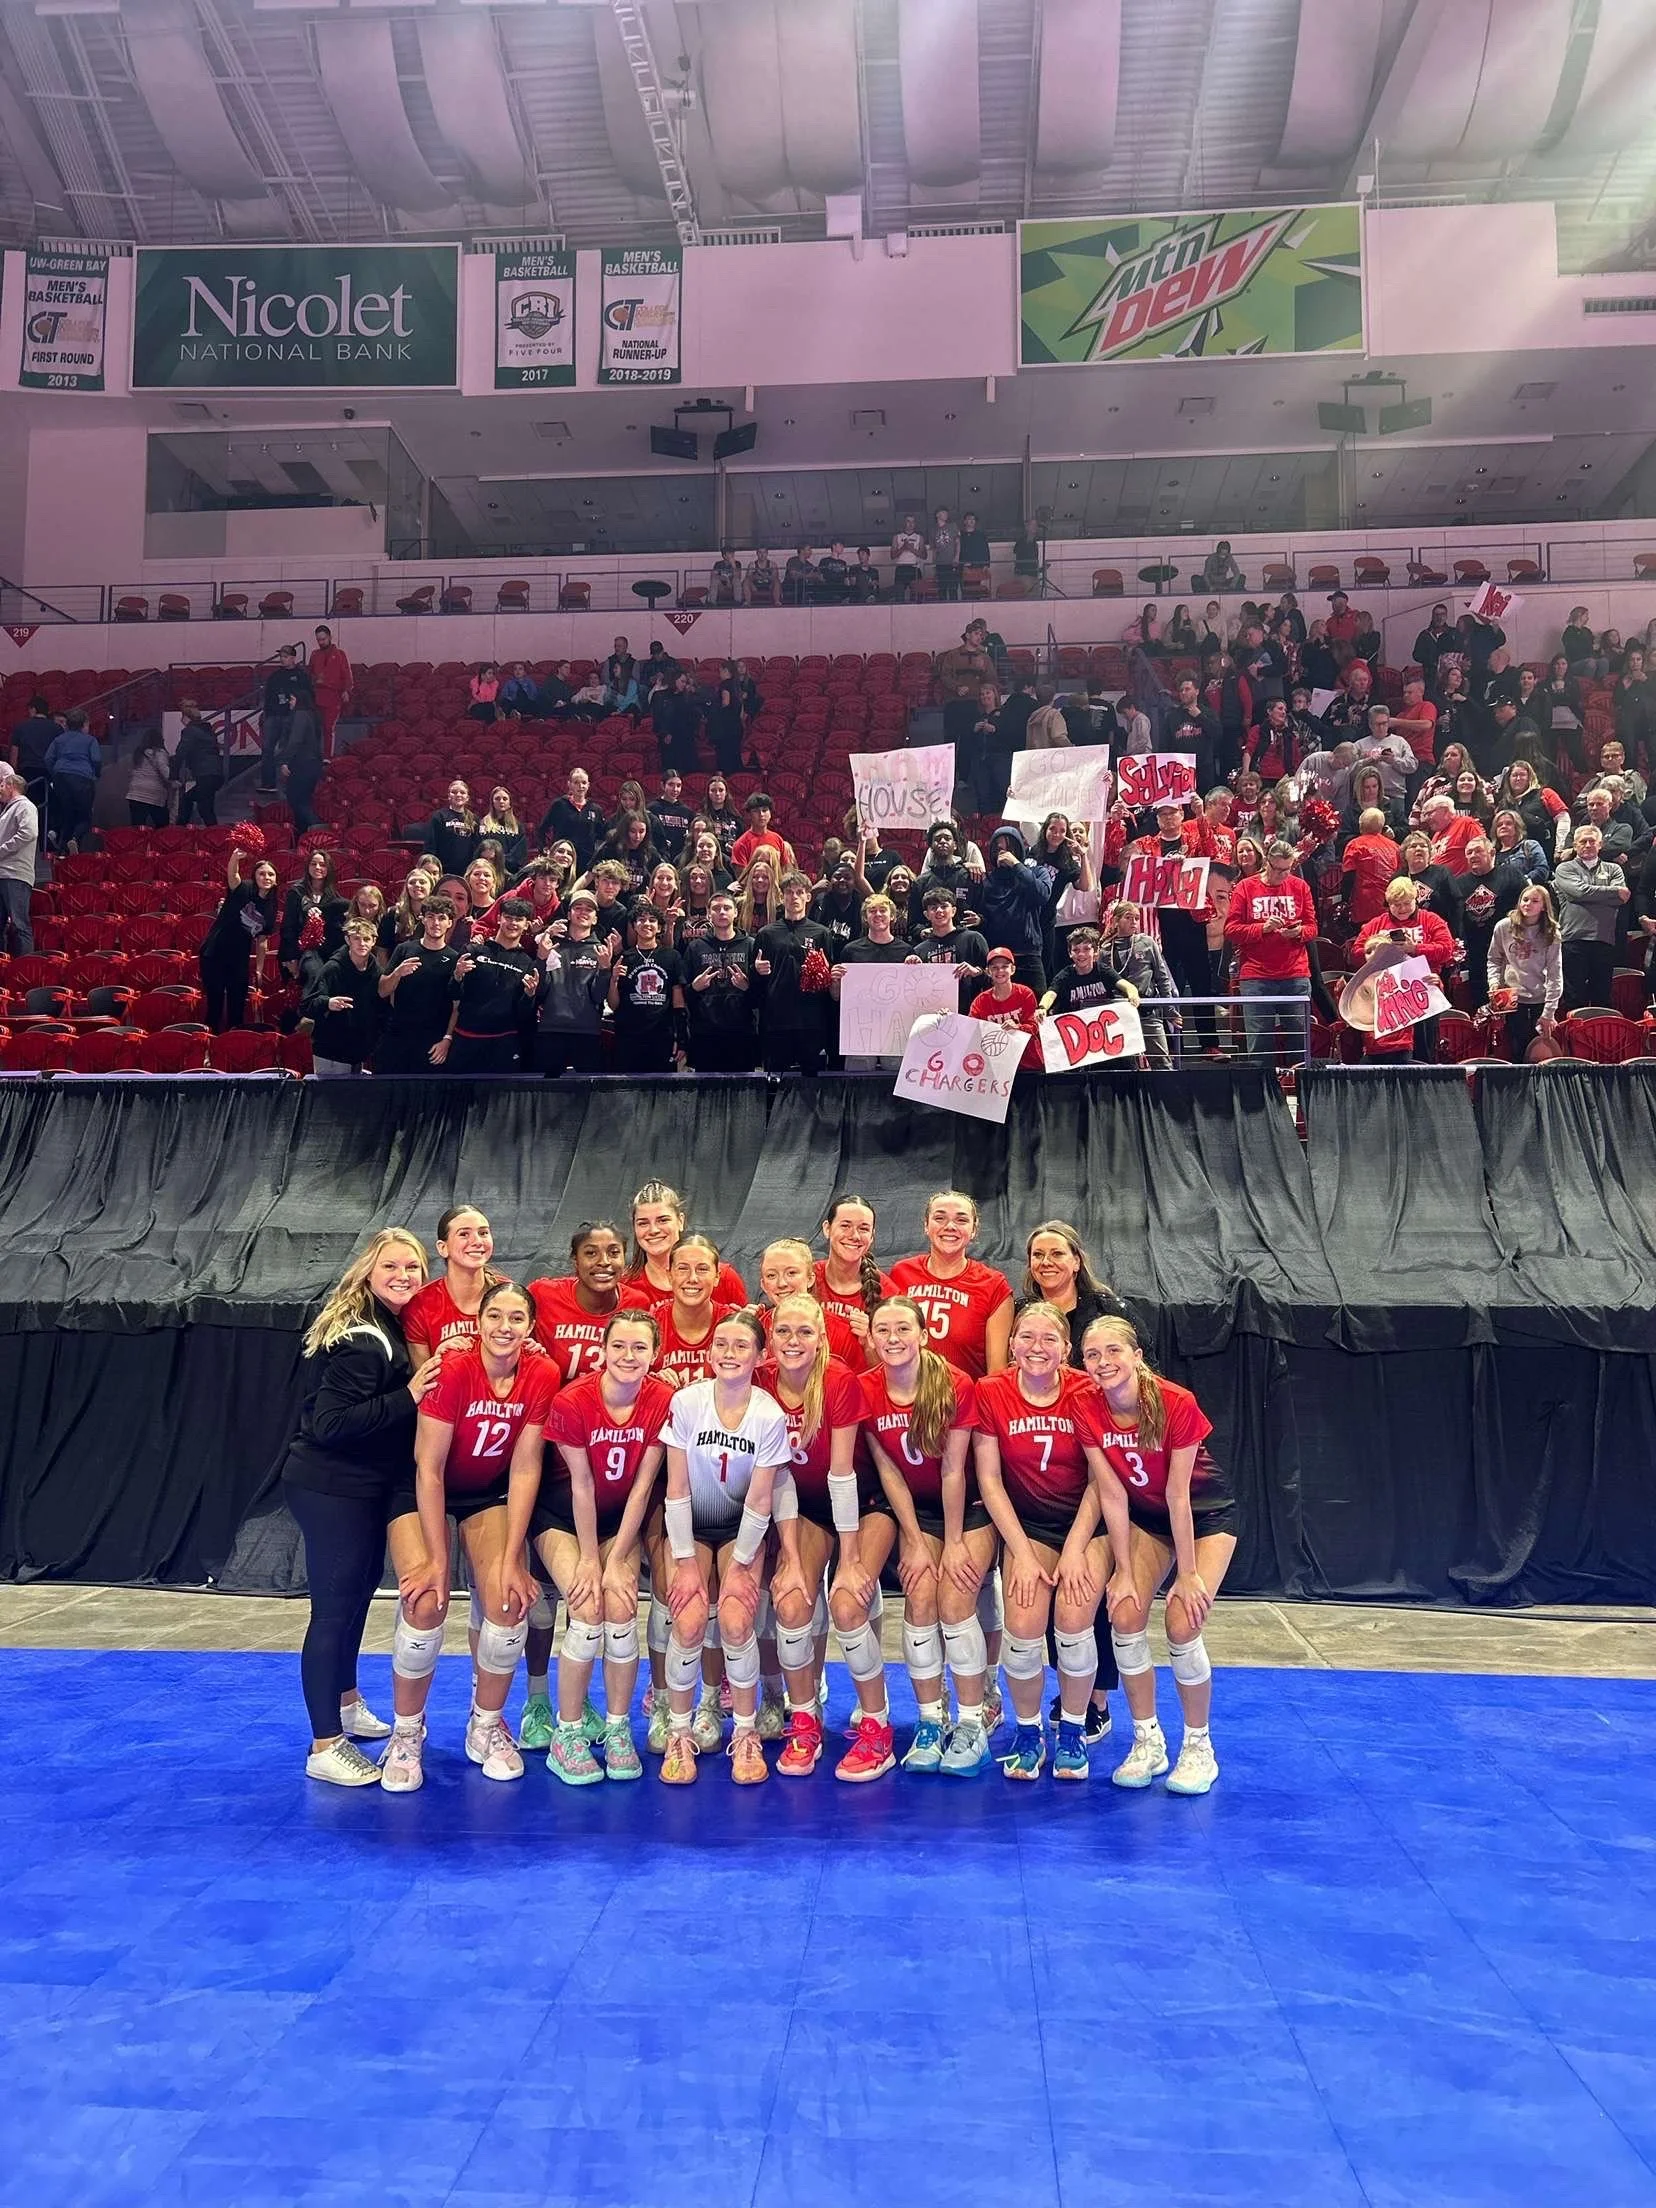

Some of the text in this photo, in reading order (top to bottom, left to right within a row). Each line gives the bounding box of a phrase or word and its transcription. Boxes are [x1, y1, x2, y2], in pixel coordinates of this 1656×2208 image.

[29, 257, 107, 272] UW-GREEN BAY
[521, 255, 555, 267] MEN'S
[622, 250, 662, 263] MEN'S
[503, 265, 569, 278] BASKETBALL
[605, 262, 679, 275] BASKETBALL
[46, 280, 87, 293] MEN'S
[28, 291, 103, 305] BASKETBALL
[180, 273, 414, 338] Nicolet
[180, 343, 412, 361] NATIONAL BANK
[509, 347, 563, 356] FIVE FOUR
[612, 348, 667, 360] RUNNER-UP
[621, 340, 660, 349] NATIONAL
[31, 352, 95, 365] FIRST ROUND
[47, 375, 78, 387] 2013
[521, 368, 549, 382] 2017
[609, 368, 672, 381] 2018-2019
[673, 614, 694, 624] 220
[12, 628, 30, 638] 219
[859, 783, 944, 822] HOUSE
[1251, 895, 1296, 914] STATE
[1253, 912, 1297, 920] BOUND
[476, 955, 523, 974] Champion
[927, 1051, 985, 1077] GO
[904, 1068, 1011, 1098] CHARGERS
[907, 1284, 970, 1307] HAMILTON
[918, 1299, 952, 1340] 15
[441, 1320, 479, 1340] HAMIL
[554, 1323, 606, 1341] HAMILT
[566, 1343, 607, 1380] 13
[663, 1349, 713, 1368] HAMILTO
[465, 1399, 525, 1419] HAMILTON
[1008, 1415, 1074, 1436] HAMILTON
[471, 1419, 511, 1458] 12
[589, 1426, 645, 1447] HAMILTON
[696, 1430, 756, 1456] HAMILTON
[1033, 1434, 1053, 1472] 7
[604, 1446, 626, 1482] 9
[718, 1451, 729, 1484] 1
[1124, 1451, 1149, 1487] 3
